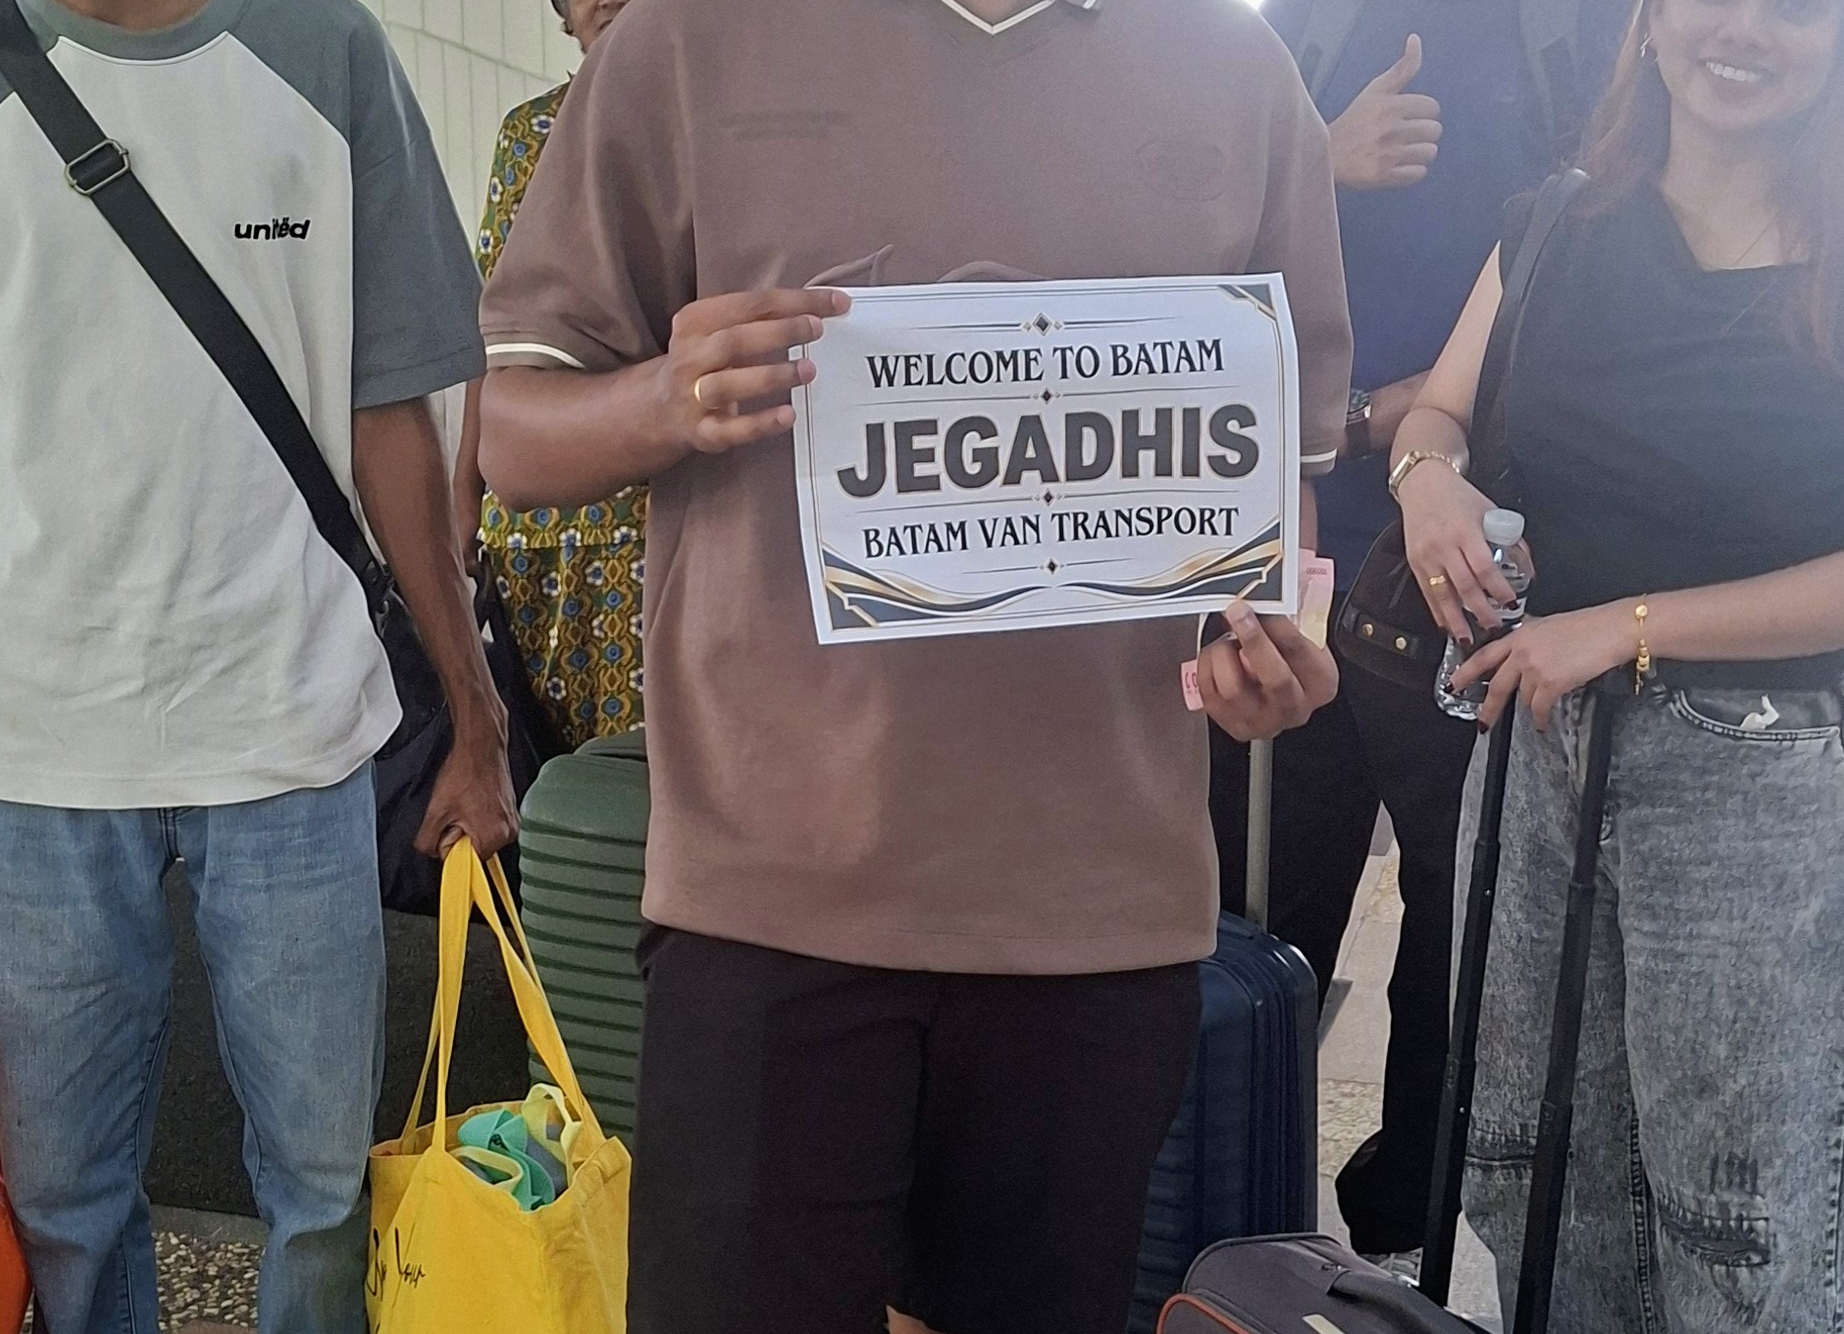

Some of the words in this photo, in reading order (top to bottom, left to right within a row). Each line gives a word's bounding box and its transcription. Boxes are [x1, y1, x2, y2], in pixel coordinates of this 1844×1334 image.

[864, 347, 1045, 389] WELCOME
[1052, 345, 1101, 382] TO
[1111, 338, 1226, 378] BATAM
[835, 402, 1261, 499] JEGADHIS
[863, 520, 969, 560] BATAM
[977, 513, 1042, 549] VAN
[1049, 506, 1240, 544] TRANSPORT
